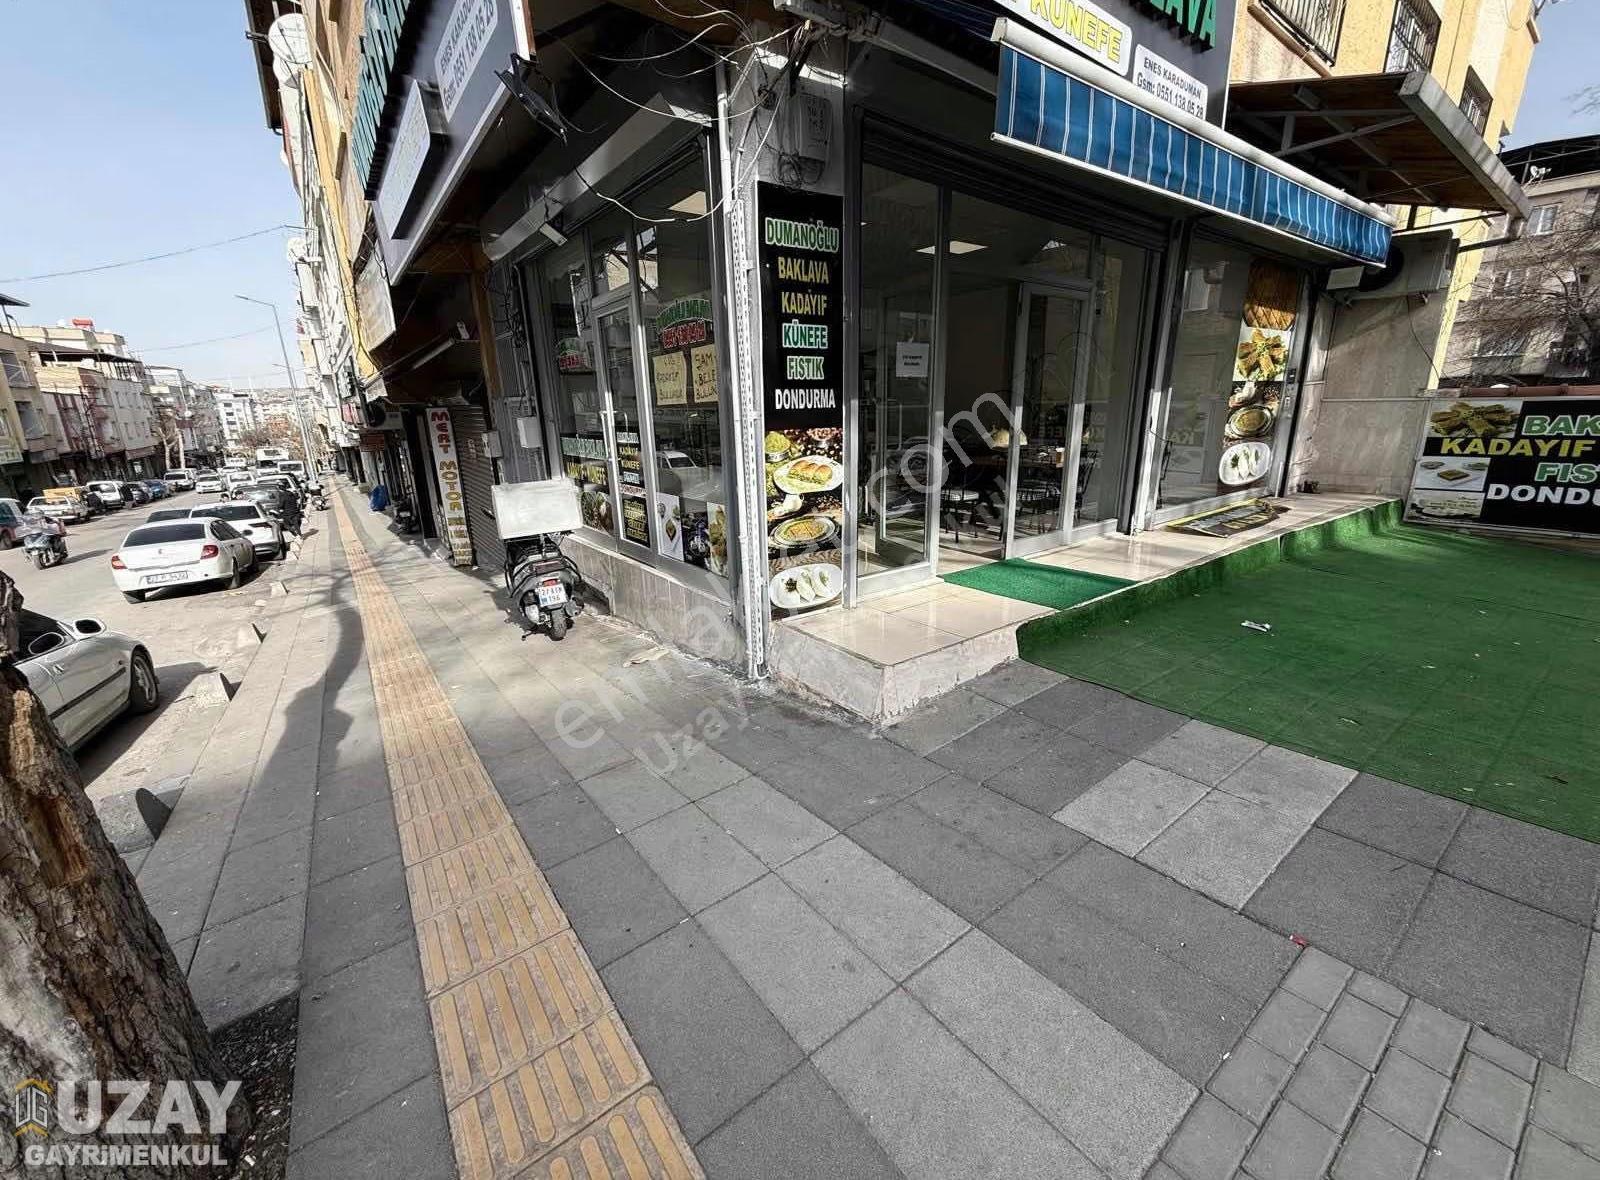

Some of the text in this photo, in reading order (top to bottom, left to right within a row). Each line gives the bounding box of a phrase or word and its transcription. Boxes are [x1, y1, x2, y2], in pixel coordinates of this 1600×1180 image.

[1143, 57, 1201, 100] ENES KARADUMAN
[765, 217, 840, 252] DUMANOĞLU
[777, 256, 829, 284] BAKLAVA
[781, 291, 827, 316] KADAYIF
[782, 319, 828, 349] KÜNEFE
[787, 355, 825, 380] FISTIK
[775, 388, 836, 410] DONDURMA
[431, 411, 449, 454] MERT
[1440, 438, 1596, 458] KADAYIF
[440, 460, 462, 511] MOTOR
[1534, 462, 1600, 484] FIS
